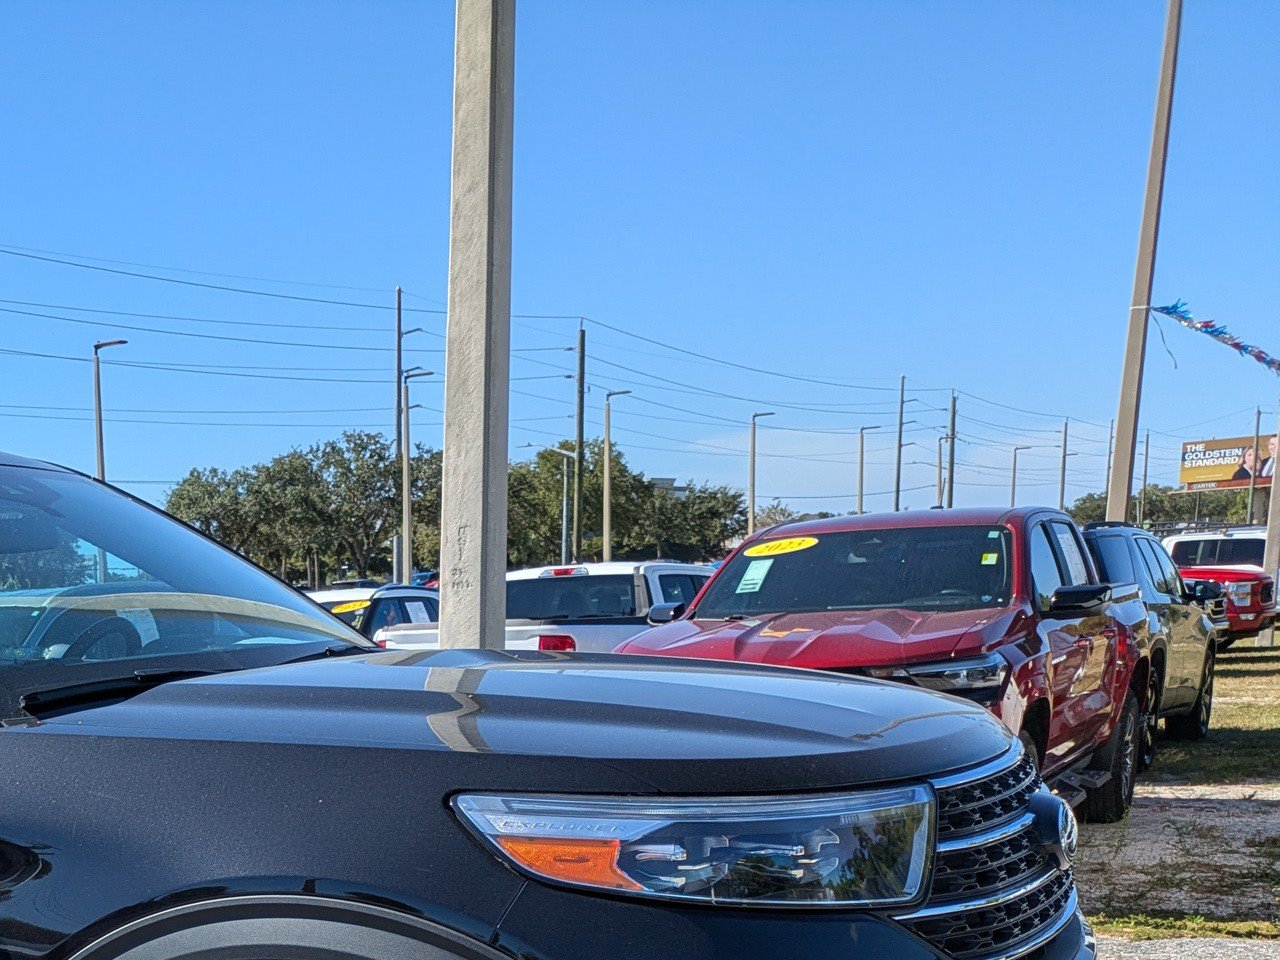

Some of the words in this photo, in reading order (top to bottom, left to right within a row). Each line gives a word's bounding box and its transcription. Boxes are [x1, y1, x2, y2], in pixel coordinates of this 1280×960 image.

[1184, 447, 1243, 460] GOLDSTEIN
[1185, 443, 1206, 453] THE
[1183, 456, 1239, 468] STANDARD
[500, 820, 626, 834] EXPLORER
